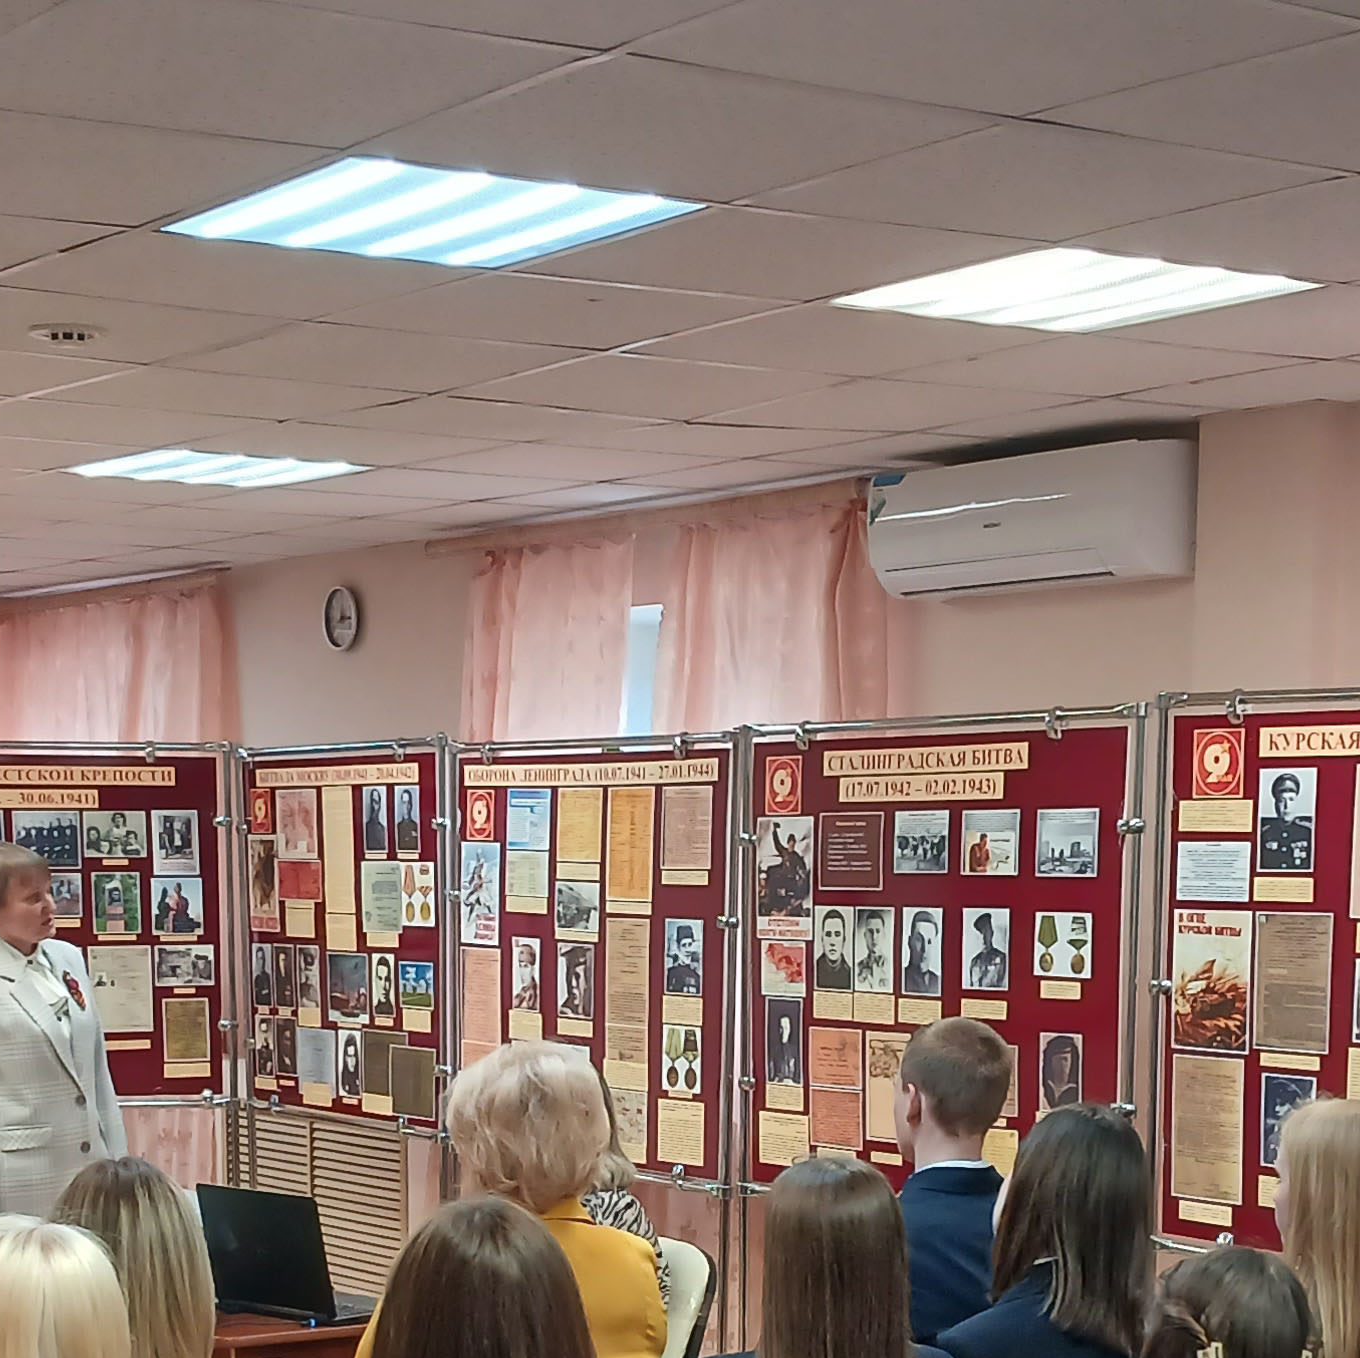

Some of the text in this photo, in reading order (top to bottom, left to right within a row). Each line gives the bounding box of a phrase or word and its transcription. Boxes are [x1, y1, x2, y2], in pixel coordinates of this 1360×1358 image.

[1268, 731, 1360, 752] КУРСКАЯ
[828, 747, 1024, 771] СТАЛИНГРАДСКАЯ БИТВА
[81, 768, 172, 782] КРЕПОСТИ
